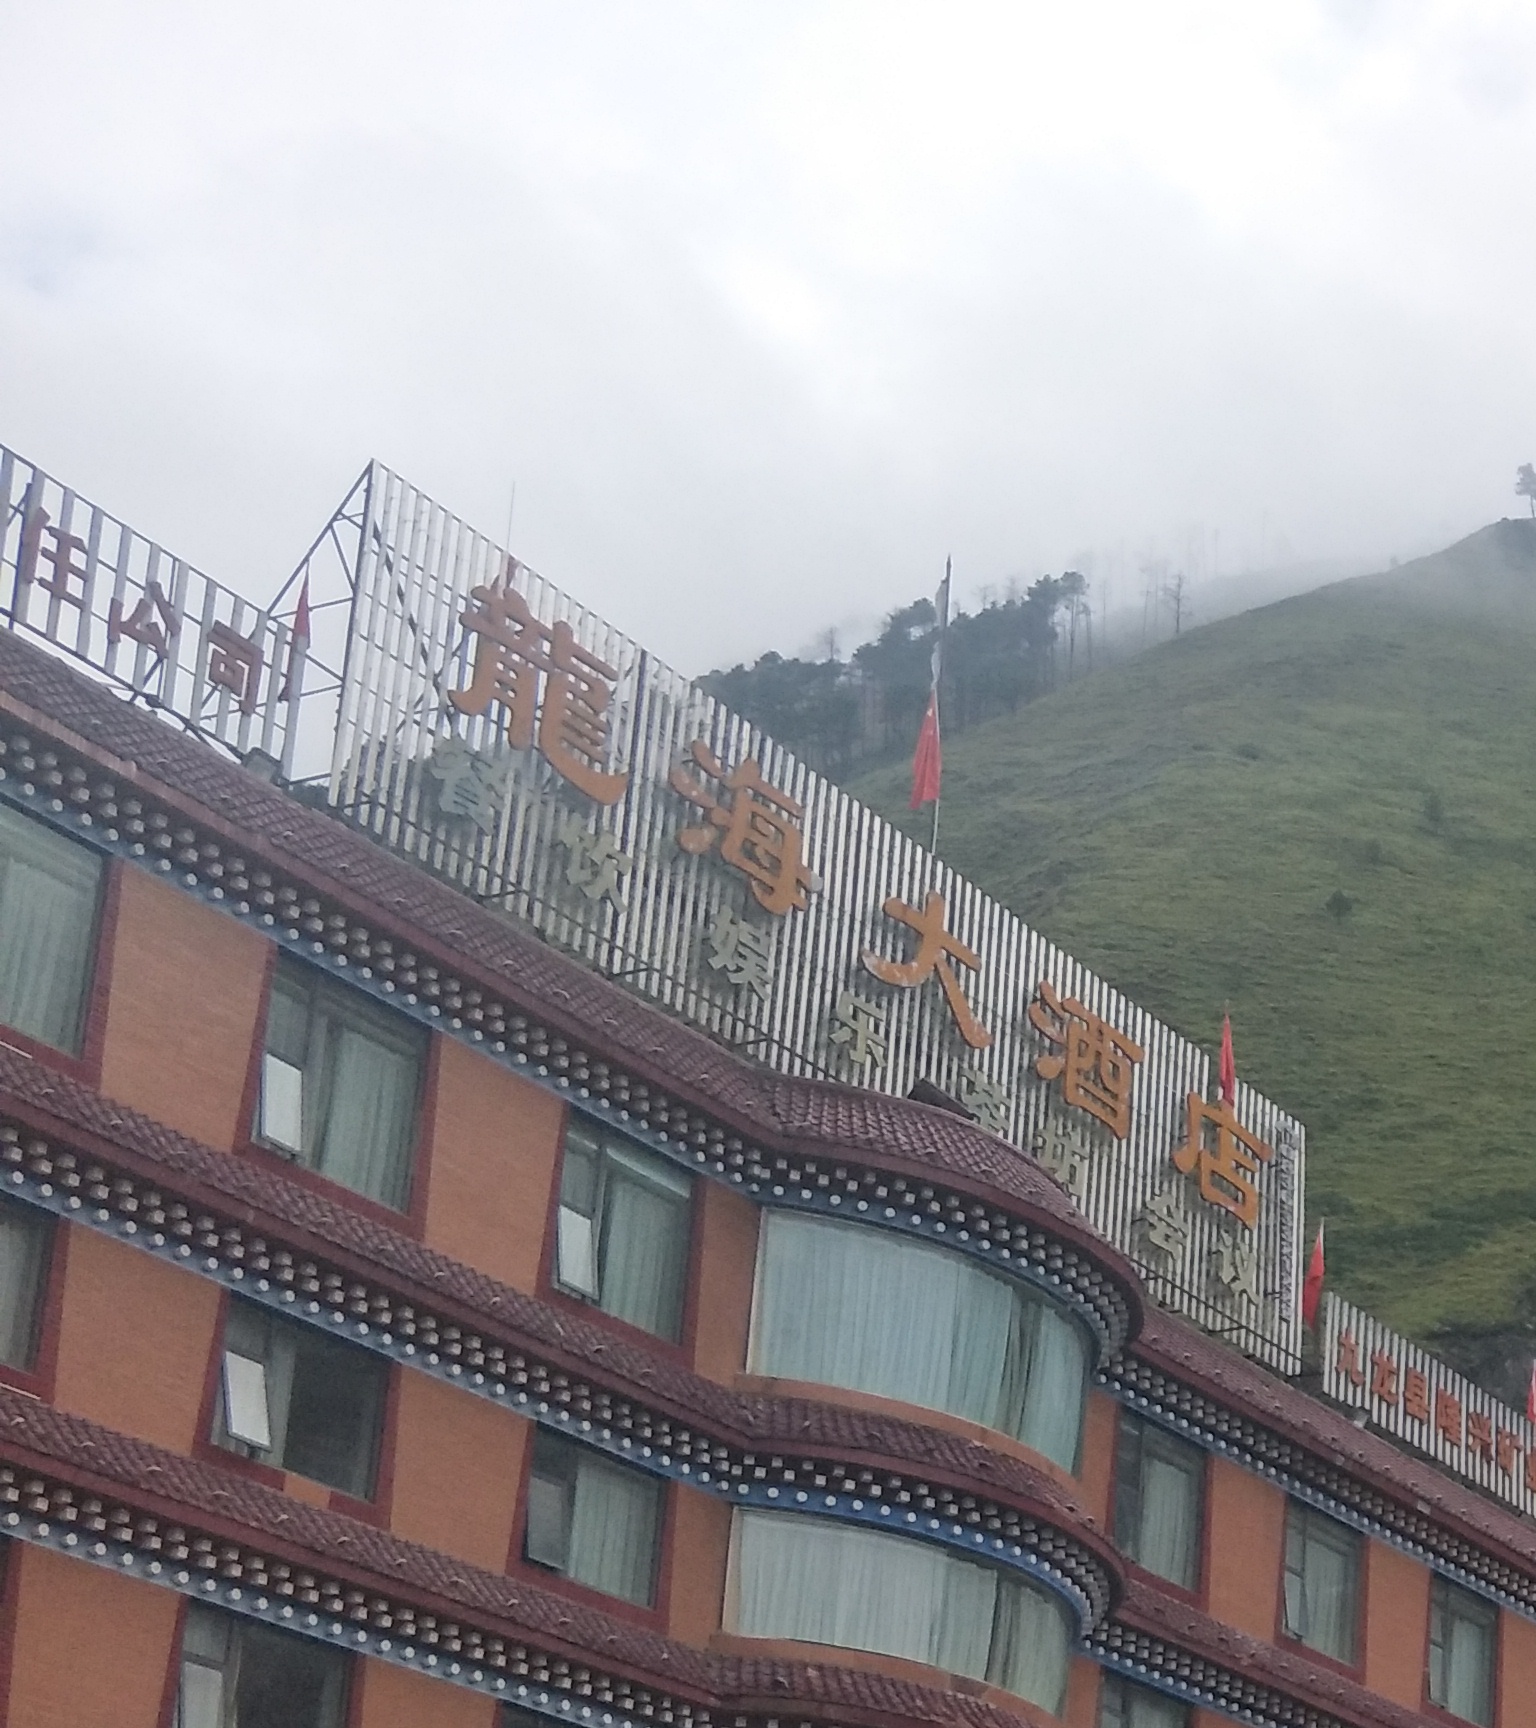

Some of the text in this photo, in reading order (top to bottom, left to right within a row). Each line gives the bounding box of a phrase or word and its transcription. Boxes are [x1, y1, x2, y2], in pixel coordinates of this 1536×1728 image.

[448, 584, 1273, 1230] 龍海大酒店
